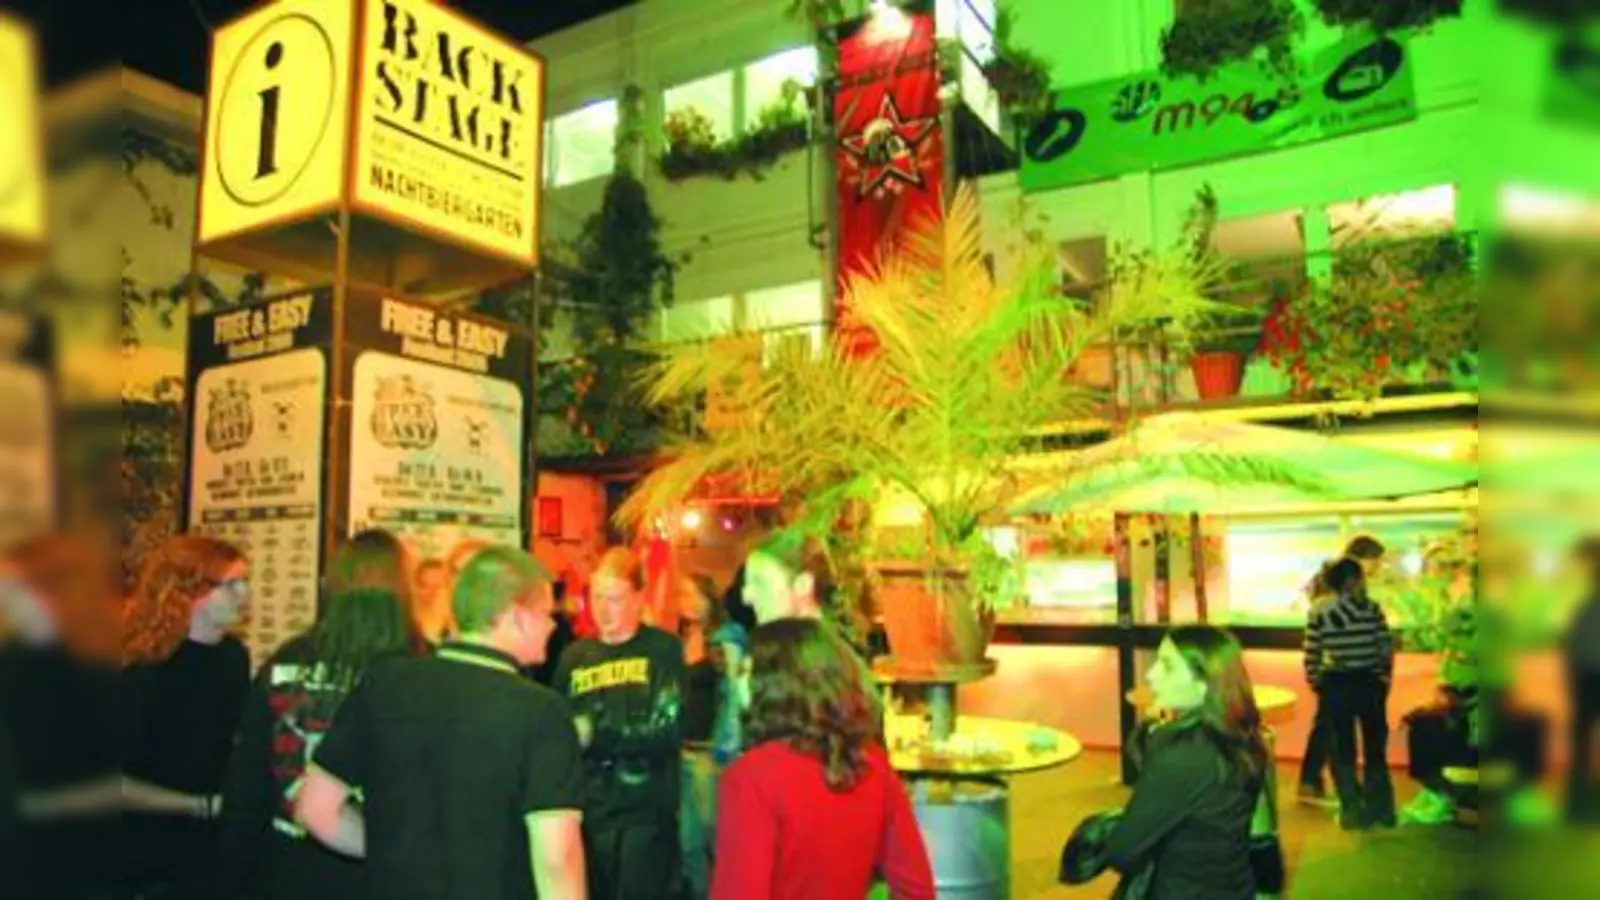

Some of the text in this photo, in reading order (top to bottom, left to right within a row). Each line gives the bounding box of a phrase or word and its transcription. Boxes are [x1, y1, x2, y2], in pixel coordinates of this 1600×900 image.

[378, 1, 525, 115] BACK
[374, 58, 526, 169] STAGE
[370, 163, 523, 240] NACHTBIERGARTEN
[213, 308, 251, 345] FREE
[252, 308, 265, 338] &
[268, 292, 314, 333] EASY
[381, 297, 436, 341] FREE
[436, 317, 454, 346] &
[457, 318, 510, 359] EASY
